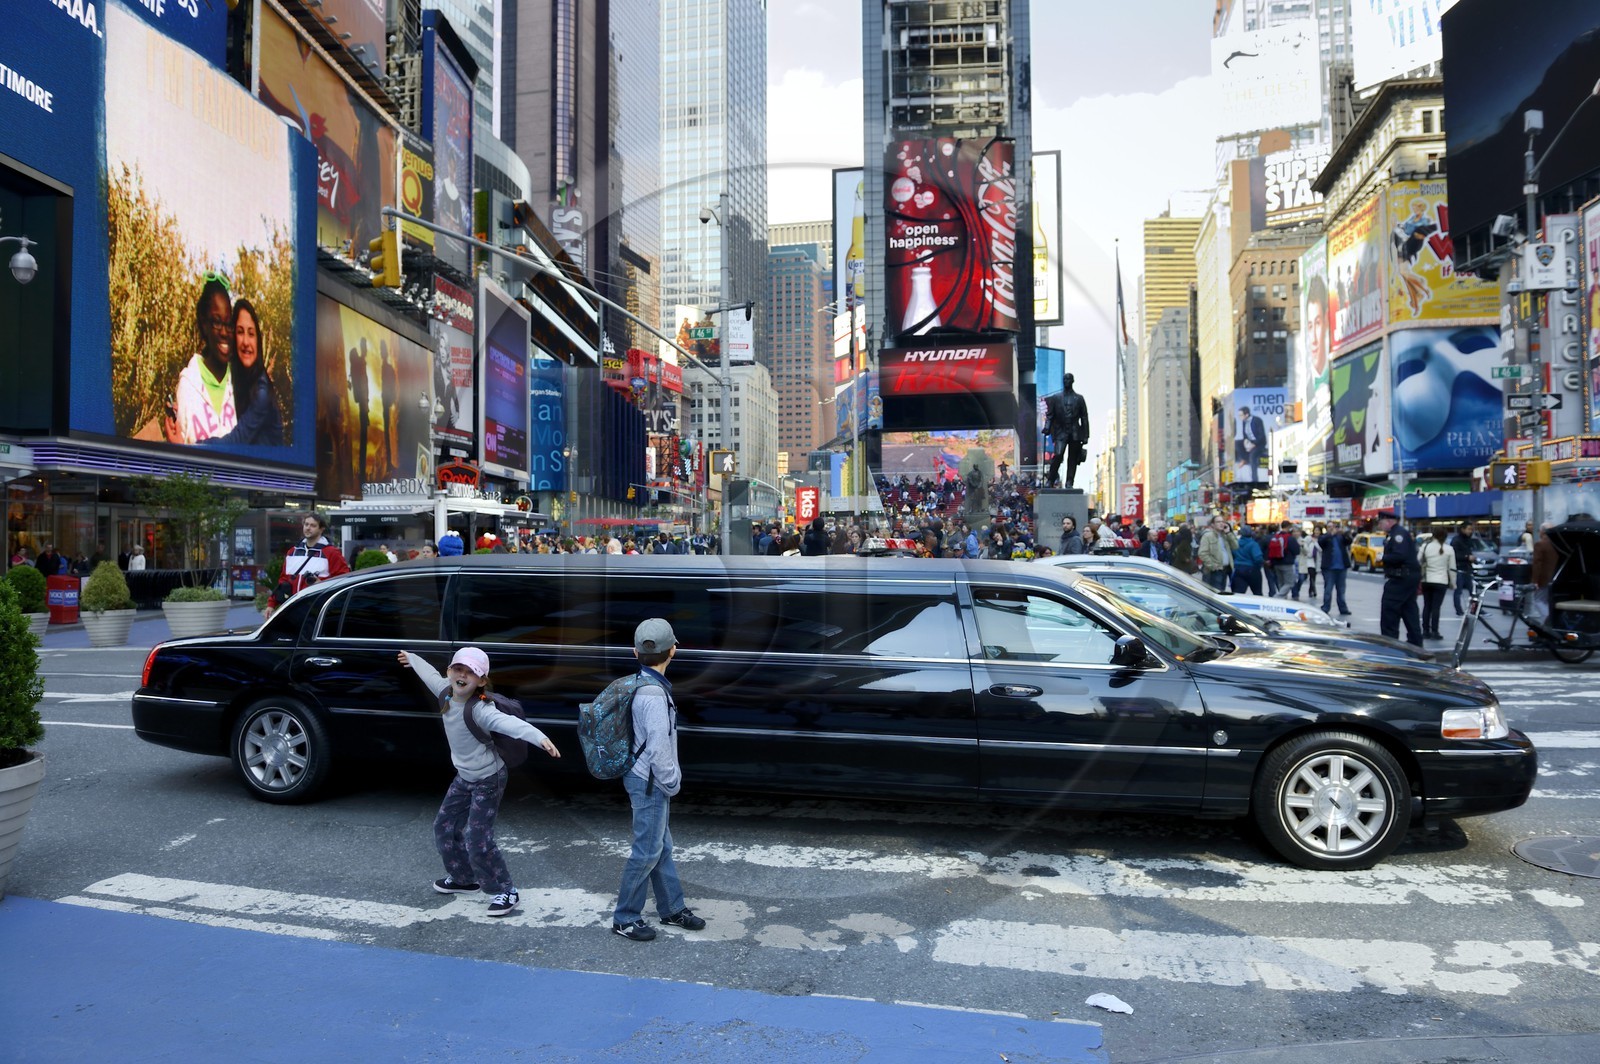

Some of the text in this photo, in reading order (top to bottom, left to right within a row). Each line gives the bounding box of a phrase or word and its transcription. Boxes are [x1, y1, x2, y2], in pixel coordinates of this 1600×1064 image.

[401, 145, 433, 180] enue
[401, 169, 422, 217] Q
[905, 224, 939, 236] open
[697, 329, 705, 339] 46
[904, 348, 987, 362] HYUNDAI
[893, 359, 1003, 392] RACE
[1501, 368, 1511, 377] 46
[1253, 394, 1285, 404] men
[362, 478, 425, 495] snackBOX
[801, 489, 816, 518] tkts
[1124, 486, 1140, 516] tkts
[1262, 604, 1285, 613] POLICE
